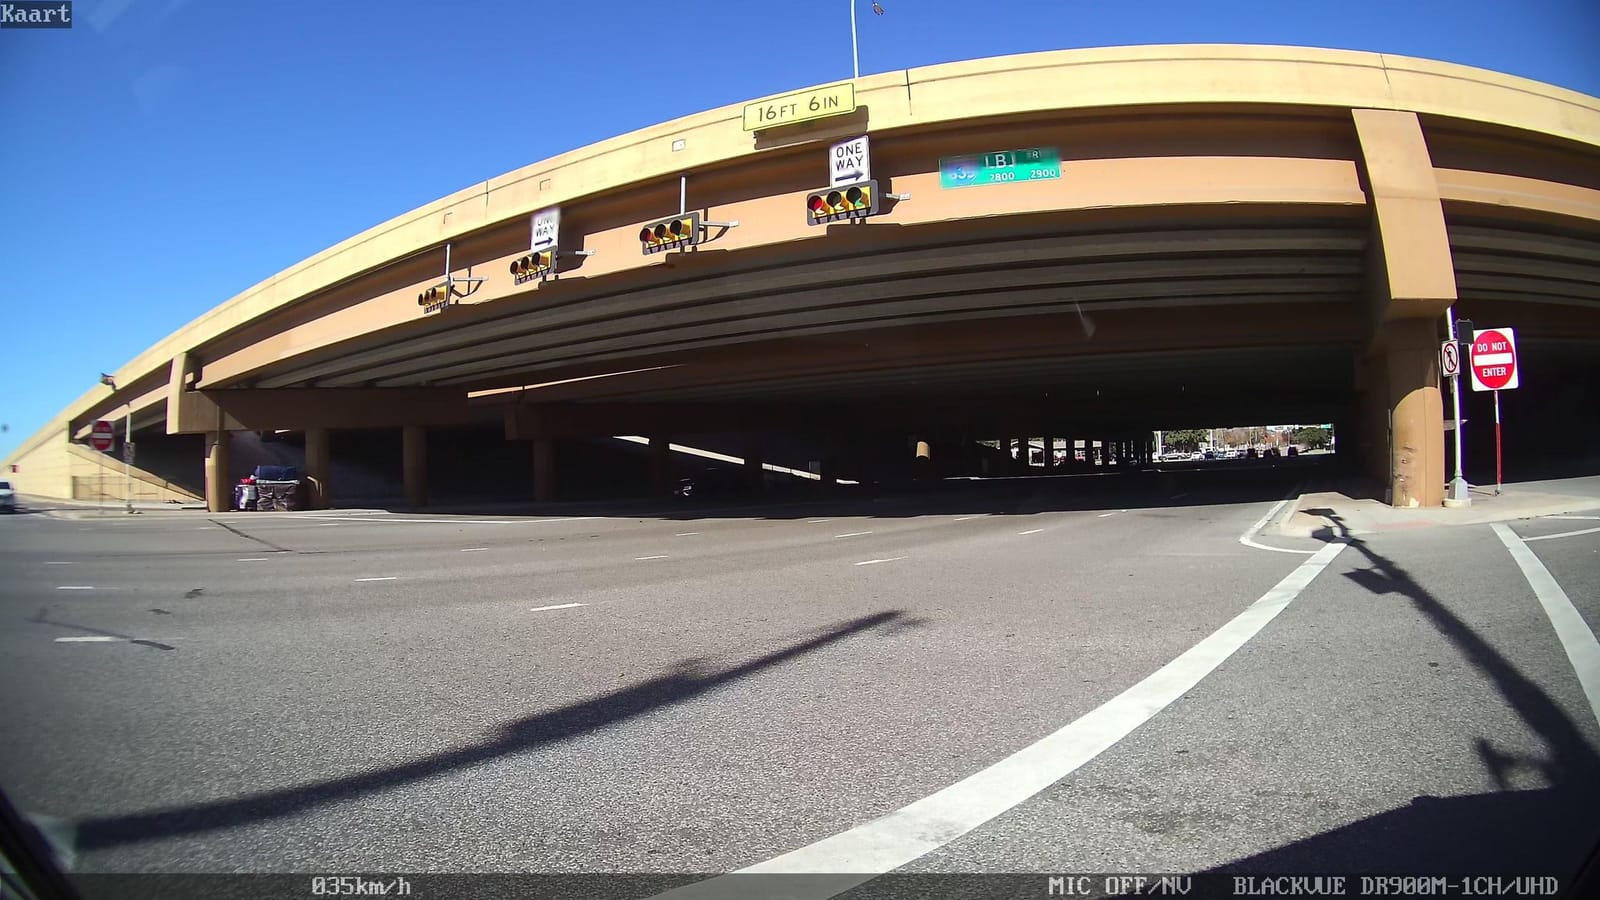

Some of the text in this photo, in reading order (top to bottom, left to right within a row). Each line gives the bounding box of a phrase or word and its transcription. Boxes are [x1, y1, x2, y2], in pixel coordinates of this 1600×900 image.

[836, 142, 863, 158] ONE
[835, 155, 864, 172] WAY
[984, 153, 1016, 169] LBJ
[989, 169, 1057, 182] 2800 2900
[1477, 341, 1507, 352] DO NOT
[1482, 367, 1507, 377] ENTER
